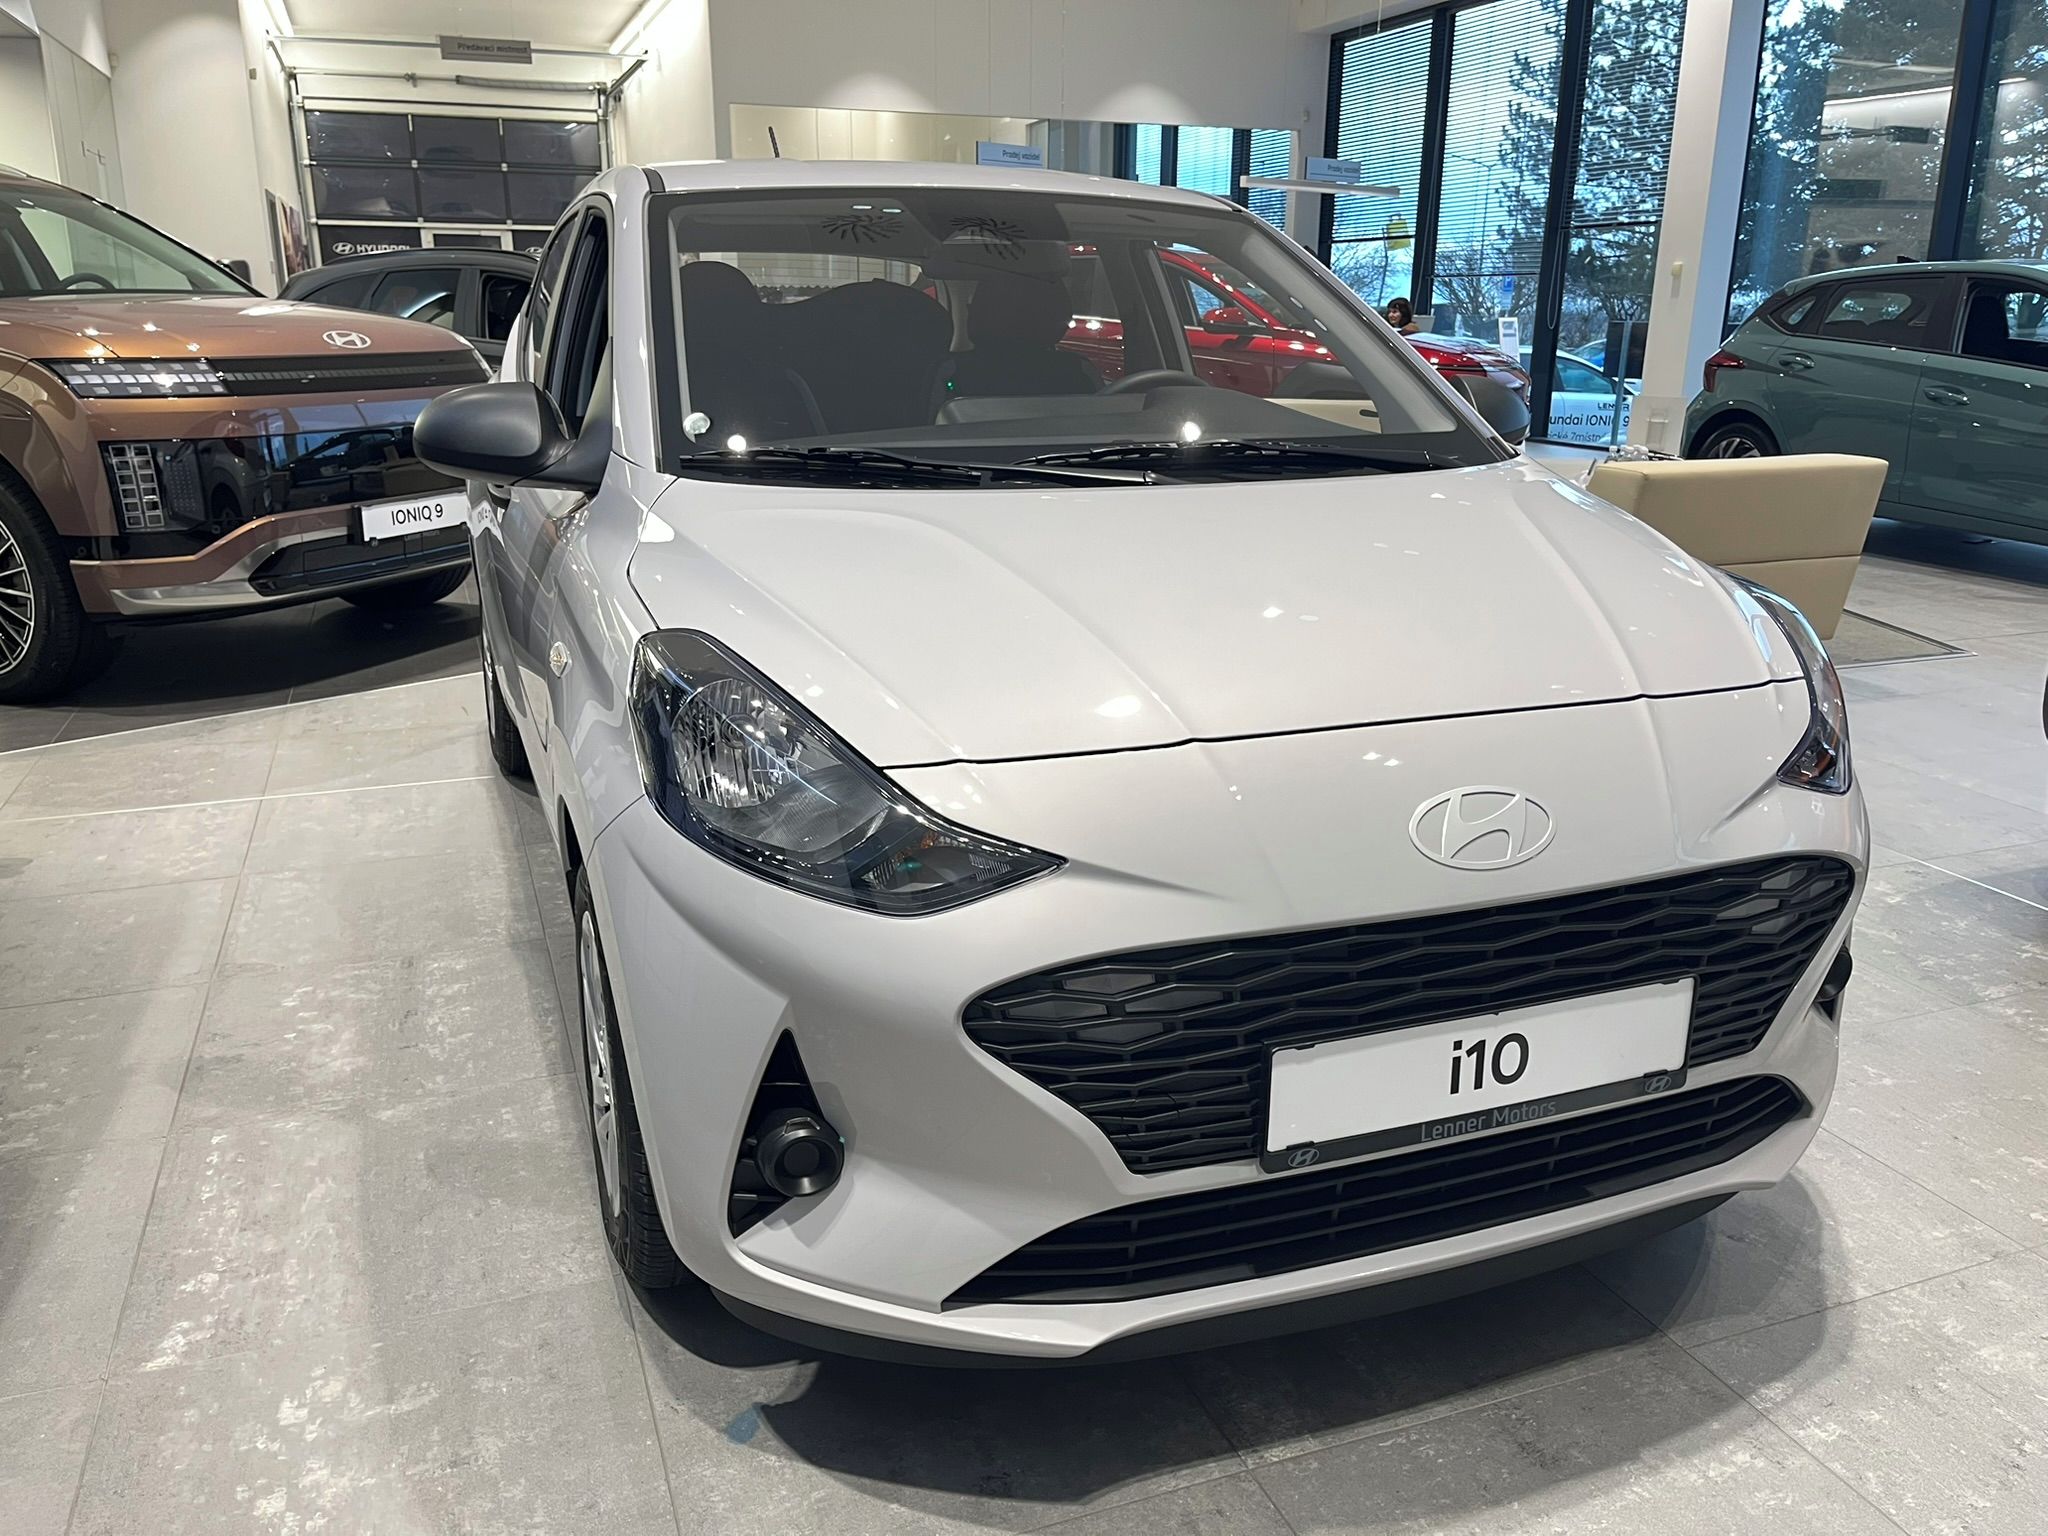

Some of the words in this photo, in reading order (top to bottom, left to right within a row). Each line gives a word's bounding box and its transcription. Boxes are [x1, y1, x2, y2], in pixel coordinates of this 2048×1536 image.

[1597, 402, 1630, 412] LENR
[1549, 413, 1584, 426] undai
[1585, 414, 1614, 427] IONI
[1622, 415, 1630, 427] 9
[391, 505, 433, 526] IONIQ
[435, 503, 444, 518] 9
[1450, 1032, 1530, 1095] i10
[1421, 1115, 1487, 1142] Lenner
[1492, 1101, 1557, 1127] Motors
